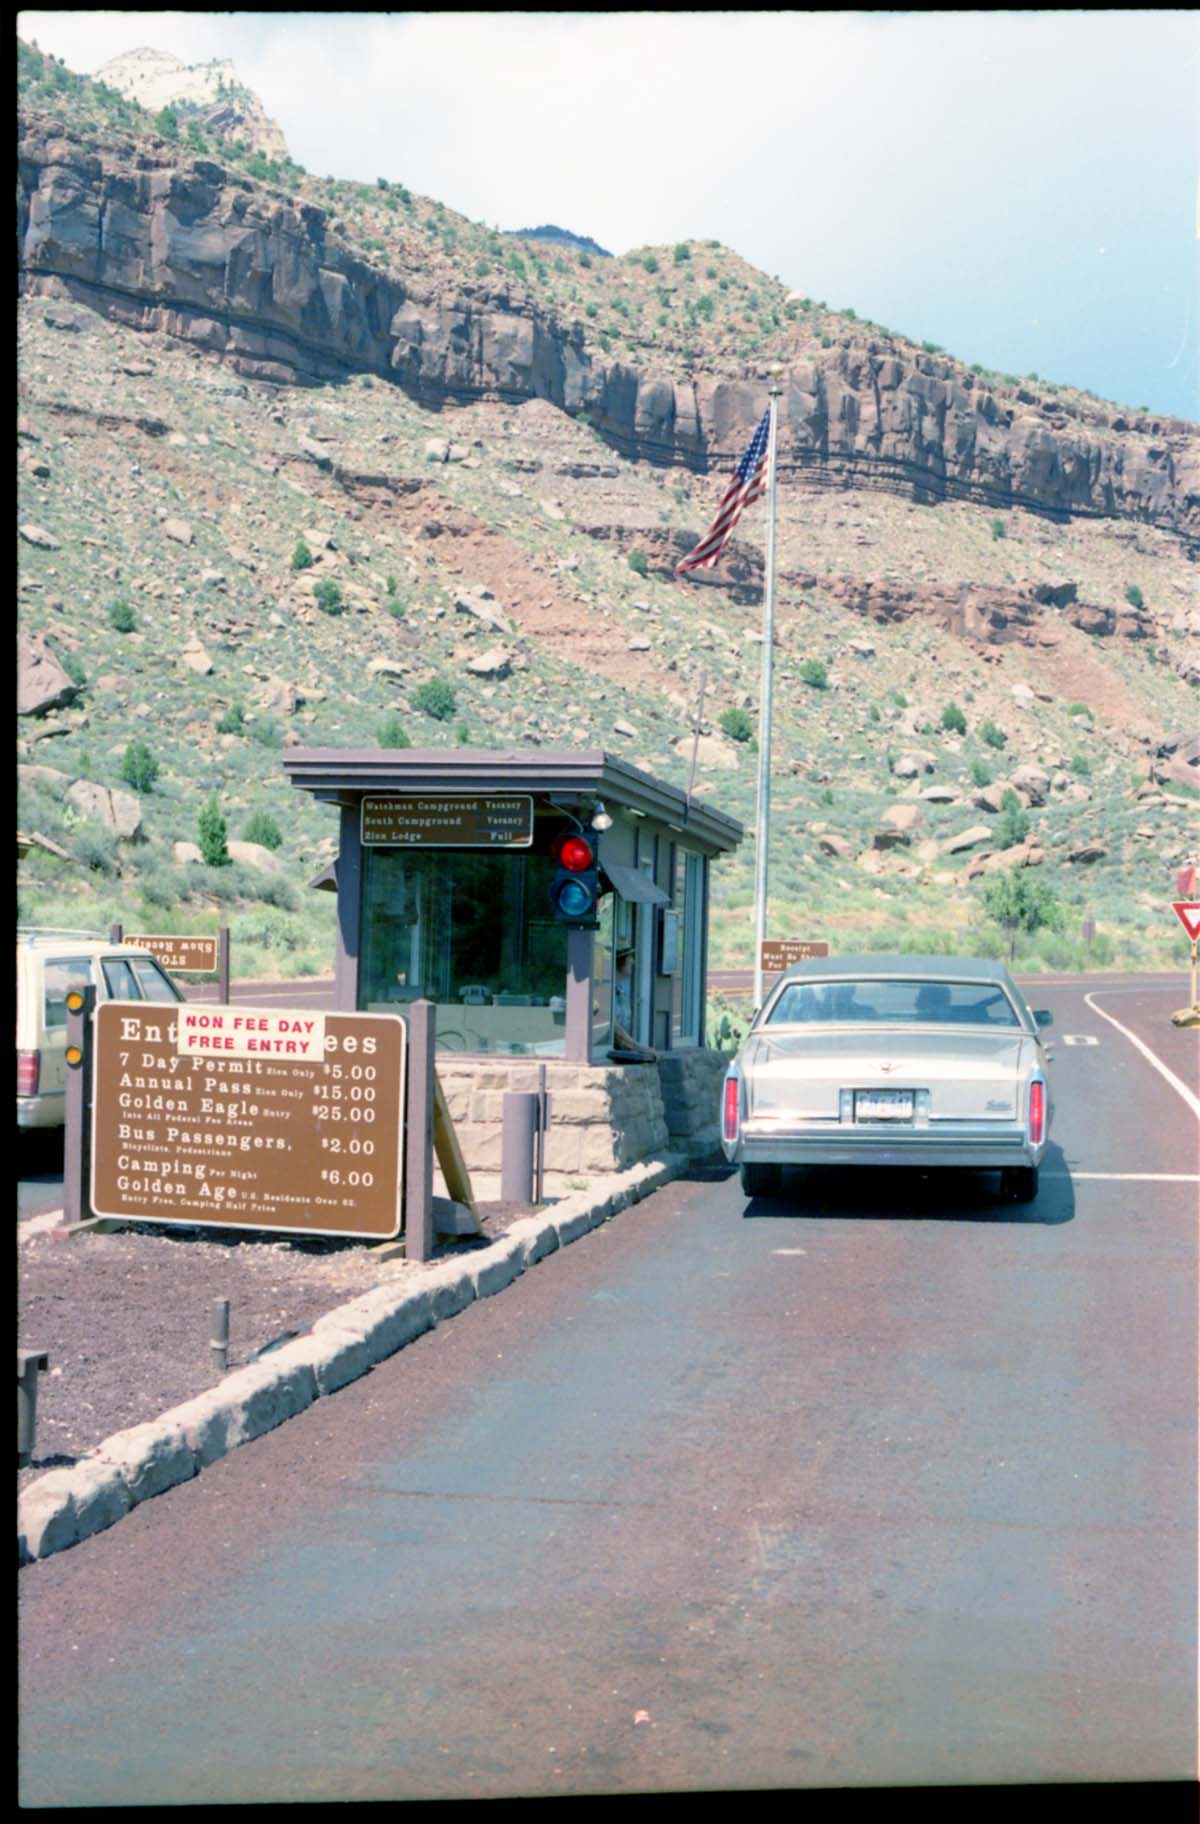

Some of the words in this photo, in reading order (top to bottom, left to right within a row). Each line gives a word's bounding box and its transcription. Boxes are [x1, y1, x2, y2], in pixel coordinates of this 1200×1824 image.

[366, 802, 413, 810] Watchman
[417, 802, 478, 812] Campground
[485, 801, 521, 810] Vacancy
[365, 817, 393, 825] South
[398, 817, 462, 827] Campground
[487, 816, 523, 826] Vacancy
[365, 832, 387, 840] Zion
[392, 832, 421, 842] Lodge
[491, 832, 512, 841] Full
[180, 942, 213, 953] Show
[186, 1016, 223, 1028] NON
[234, 1018, 269, 1031] FEE
[278, 1020, 315, 1033] DAY
[188, 1035, 235, 1049] FREE
[247, 1038, 310, 1053] ENTRY
[325, 1035, 377, 1054] ees
[120, 1052, 130, 1066] 7
[142, 1053, 179, 1073] Day
[192, 1056, 262, 1074] Permit
[266, 1067, 288, 1076] Zion
[292, 1069, 315, 1079] Only
[324, 1064, 377, 1081] $5.00
[119, 1073, 192, 1091] Annual
[205, 1078, 251, 1095] Pass
[255, 1088, 277, 1096] Zion
[281, 1089, 304, 1099] Only
[313, 1085, 376, 1102] $15.00
[119, 1093, 188, 1112] Golden
[200, 1098, 259, 1118] Eagle
[263, 1109, 291, 1119] Entry
[312, 1105, 376, 1122] $25.00
[146, 1113, 161, 1121] All
[165, 1114, 201, 1123] Federal
[205, 1117, 222, 1125] Fee
[226, 1118, 254, 1127] Areas
[118, 1124, 155, 1140] Bus
[166, 1127, 293, 1152] Passengers,
[321, 1138, 375, 1155] $2.00
[176, 1146, 232, 1156] Pedestrians
[118, 1155, 206, 1180] Camping
[209, 1168, 226, 1177] Per
[230, 1169, 258, 1180] Night
[321, 1169, 374, 1187] $6.00
[117, 1176, 187, 1195] Golden
[198, 1181, 237, 1202] Age
[263, 1193, 311, 1204] Residents
[315, 1196, 338, 1206] Over
[121, 1194, 148, 1204] Entry
[180, 1198, 221, 1209] Camping
[225, 1202, 247, 1211] Half
[251, 1203, 277, 1213] Price
